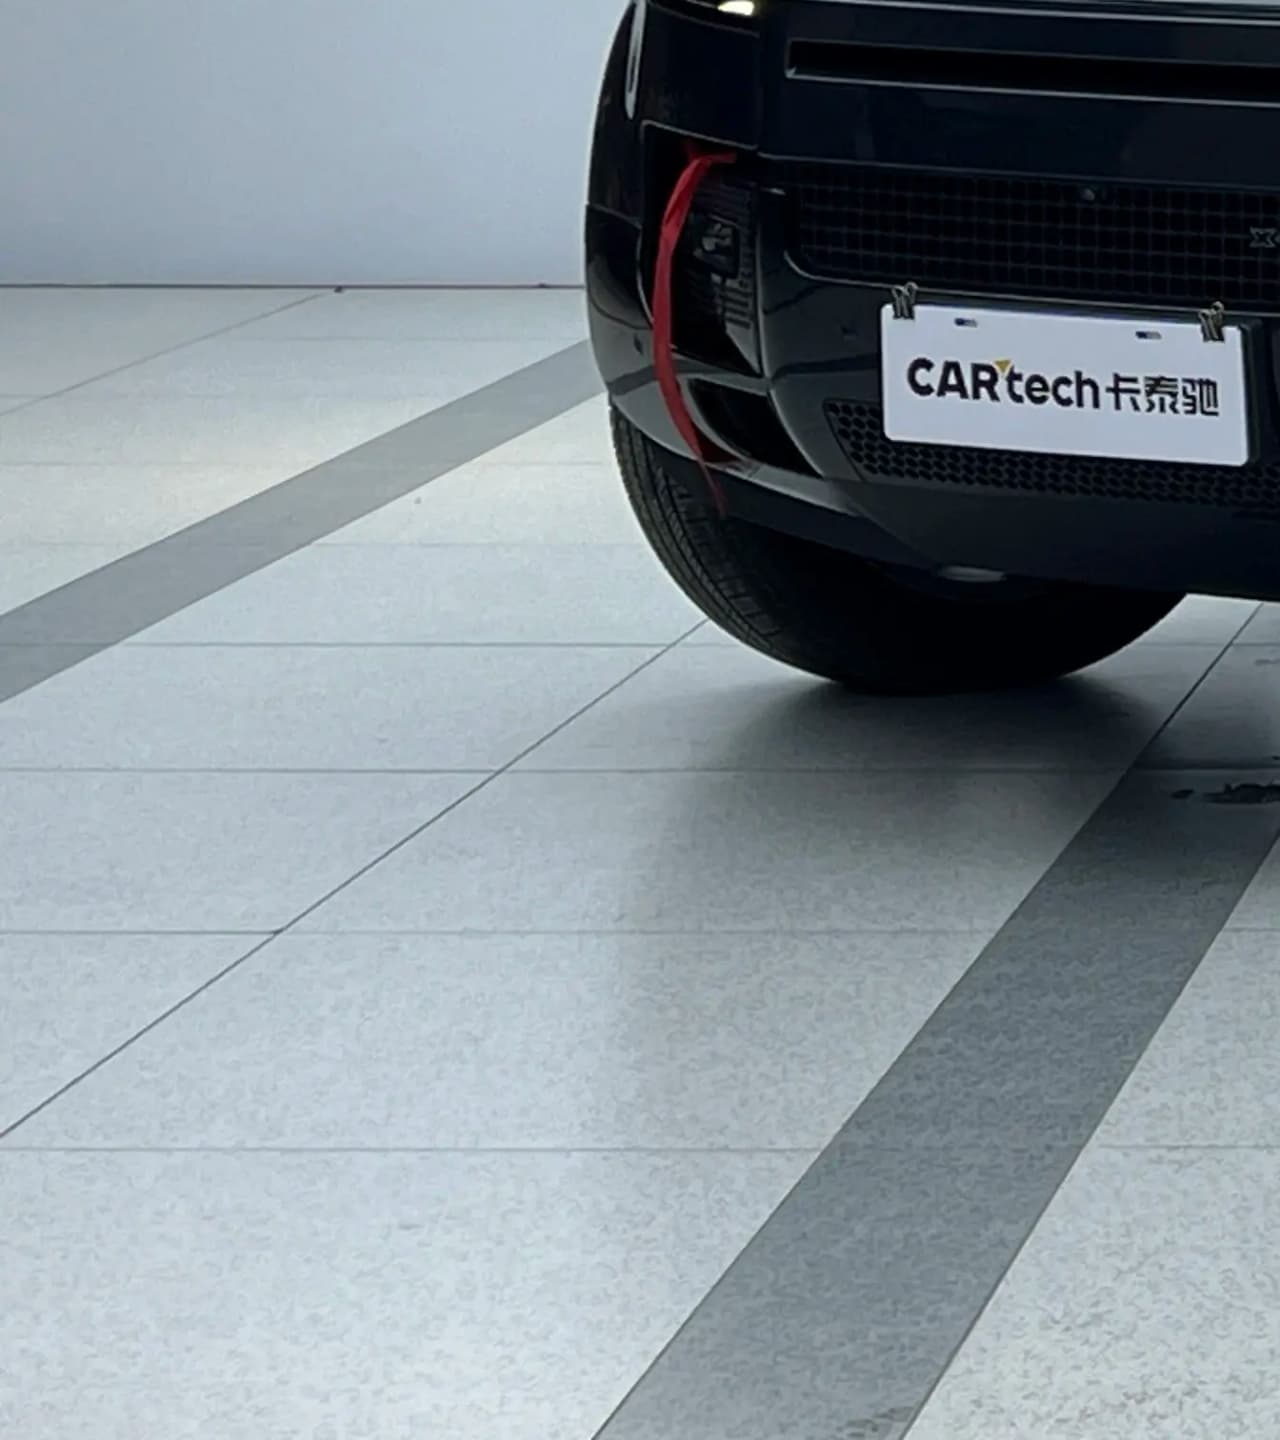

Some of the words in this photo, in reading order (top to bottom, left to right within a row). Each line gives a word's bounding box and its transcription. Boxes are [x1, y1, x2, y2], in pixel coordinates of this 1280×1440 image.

[907, 356, 1101, 411] CARtech
[1104, 371, 1221, 418] 卡泰驰
